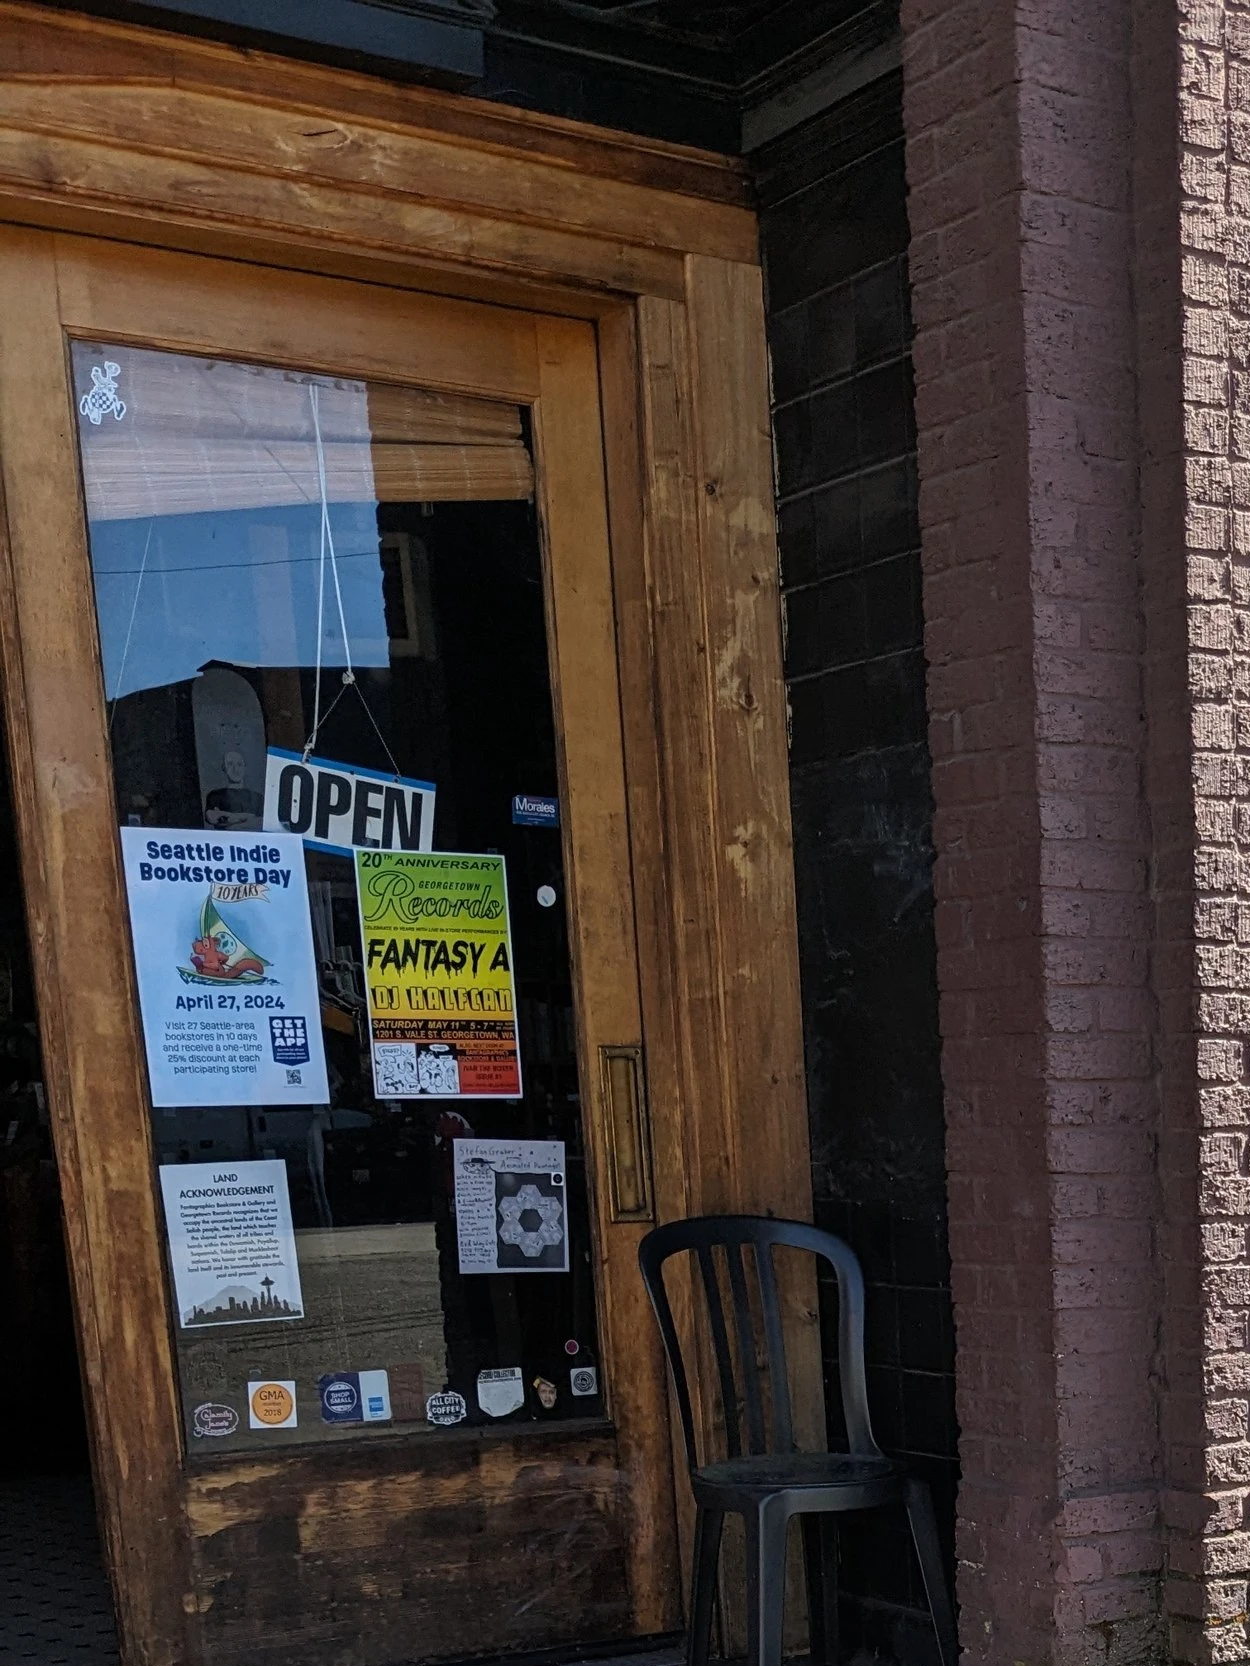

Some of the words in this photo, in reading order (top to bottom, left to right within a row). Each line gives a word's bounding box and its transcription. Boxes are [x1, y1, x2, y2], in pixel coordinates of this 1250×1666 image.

[278, 764, 423, 851] OPEN
[515, 797, 555, 813] Morales
[146, 841, 224, 862] Seattle
[230, 845, 281, 863] Indie
[394, 858, 501, 871] ANNIVERSARY
[139, 862, 249, 885] Bookstore
[254, 867, 292, 888] Day
[418, 880, 481, 891] GEORGETOWN
[217, 886, 229, 900] 10
[231, 885, 259, 900] YEARS
[364, 870, 504, 924] Records
[367, 938, 486, 977] FANTASY
[489, 942, 510, 974] A
[176, 995, 214, 1012] April
[218, 995, 240, 1012] 27,
[244, 995, 285, 1010] 2024
[371, 985, 400, 1010] DJ
[406, 986, 513, 1012] HALFCAN
[165, 1021, 185, 1030] Visit
[187, 1021, 198, 1030] 27
[200, 1021, 255, 1030] Seattle-area
[272, 1019, 303, 1028] GET
[372, 1020, 423, 1029] SATURDAY
[427, 1020, 449, 1029] MAY
[470, 1022, 476, 1030] 5
[165, 1033, 214, 1041] bookstores
[216, 1033, 225, 1041] in
[237, 1033, 257, 1042] days
[272, 1028, 305, 1037] THE
[502, 1031, 514, 1039] WA
[274, 1037, 306, 1047] APP
[162, 1044, 179, 1052] and
[181, 1044, 213, 1052] receive
[223, 1044, 263, 1052] one-time
[167, 1054, 187, 1063] 25%
[188, 1054, 226, 1063] discount
[228, 1054, 237, 1063] at
[239, 1054, 260, 1062] each
[174, 1065, 229, 1075] participating
[213, 1174, 238, 1183] LAND
[180, 1185, 274, 1199] ACKNOWLEDGEMENT
[259, 1390, 285, 1401] GMA
[444, 1396, 459, 1404] CITY
[264, 1409, 282, 1417] 2018
[432, 1406, 460, 1414] COFFEE
